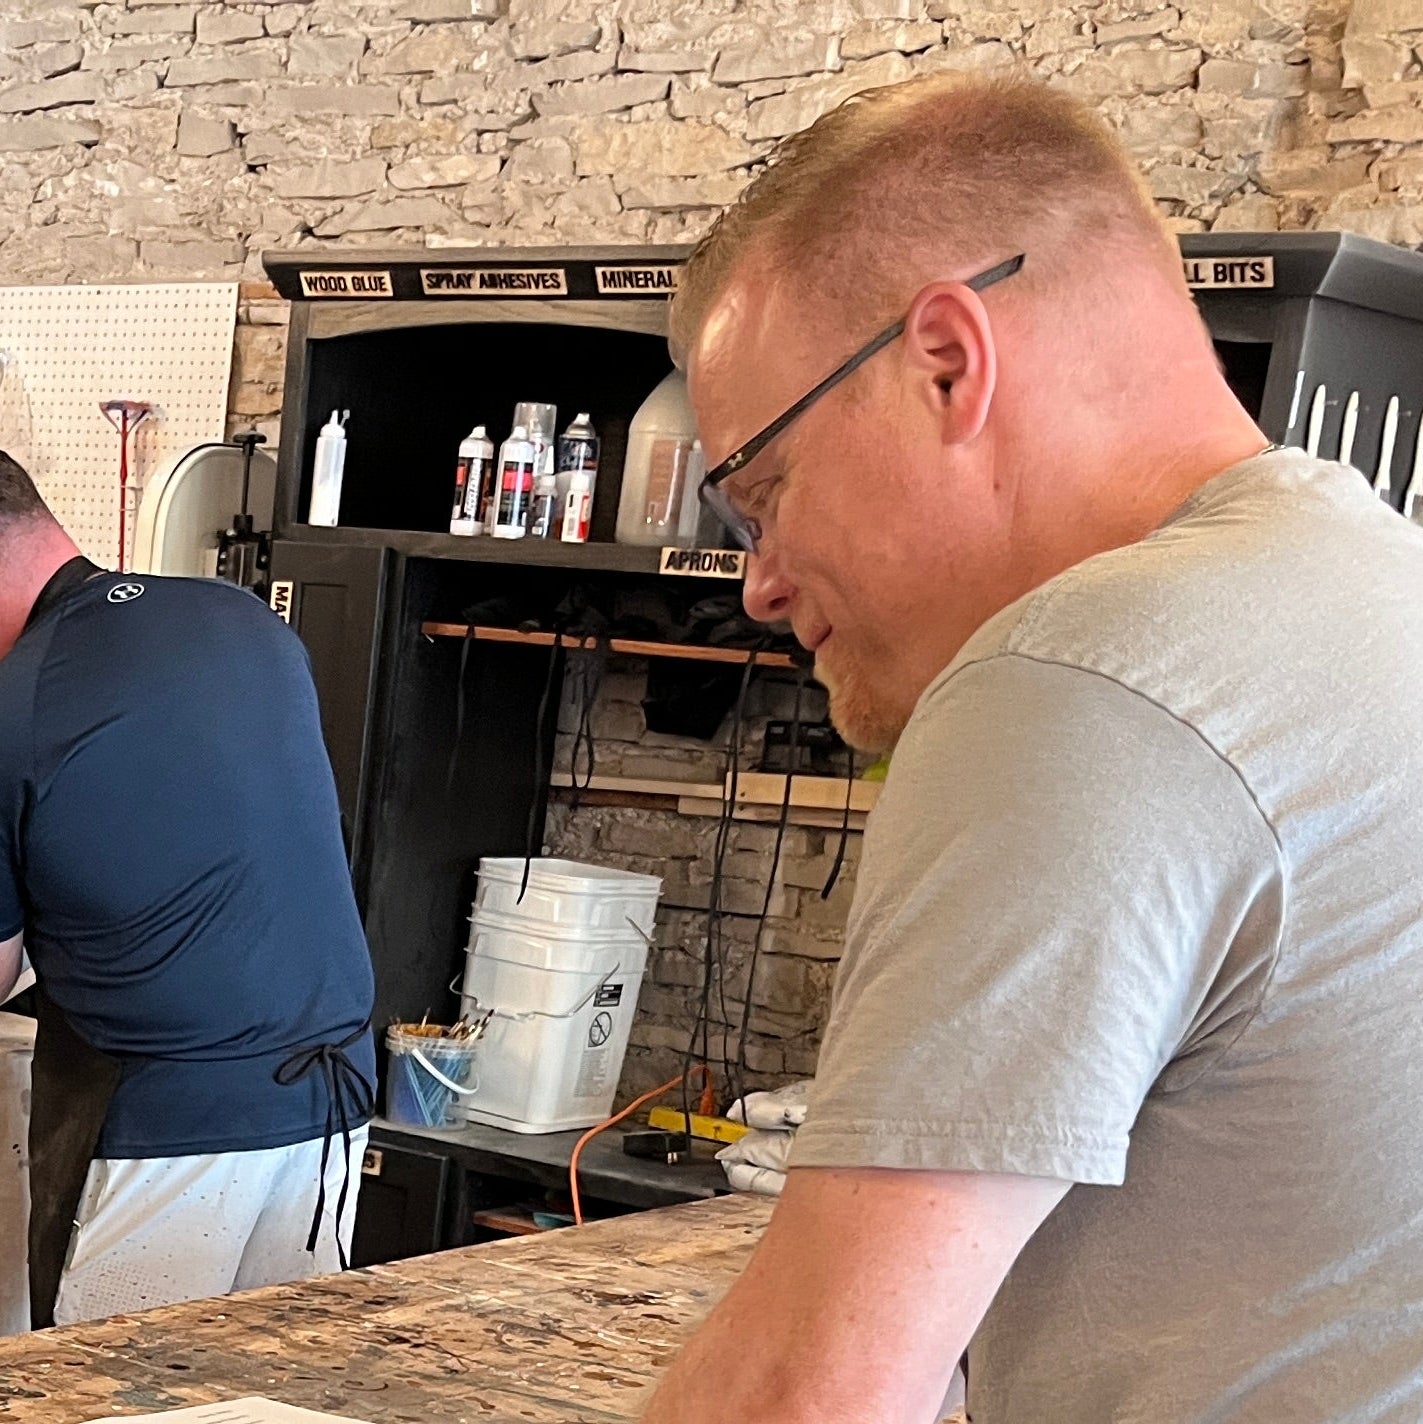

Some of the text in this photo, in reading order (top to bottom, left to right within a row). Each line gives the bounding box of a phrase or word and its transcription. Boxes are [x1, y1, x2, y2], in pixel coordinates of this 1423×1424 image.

[425, 272, 562, 290] SPRAY ADHESIVES
[601, 270, 678, 289] MINERAL
[1213, 262, 1265, 283] BITS
[304, 275, 388, 292] WOOD GLUE
[665, 550, 739, 573] APRONS
